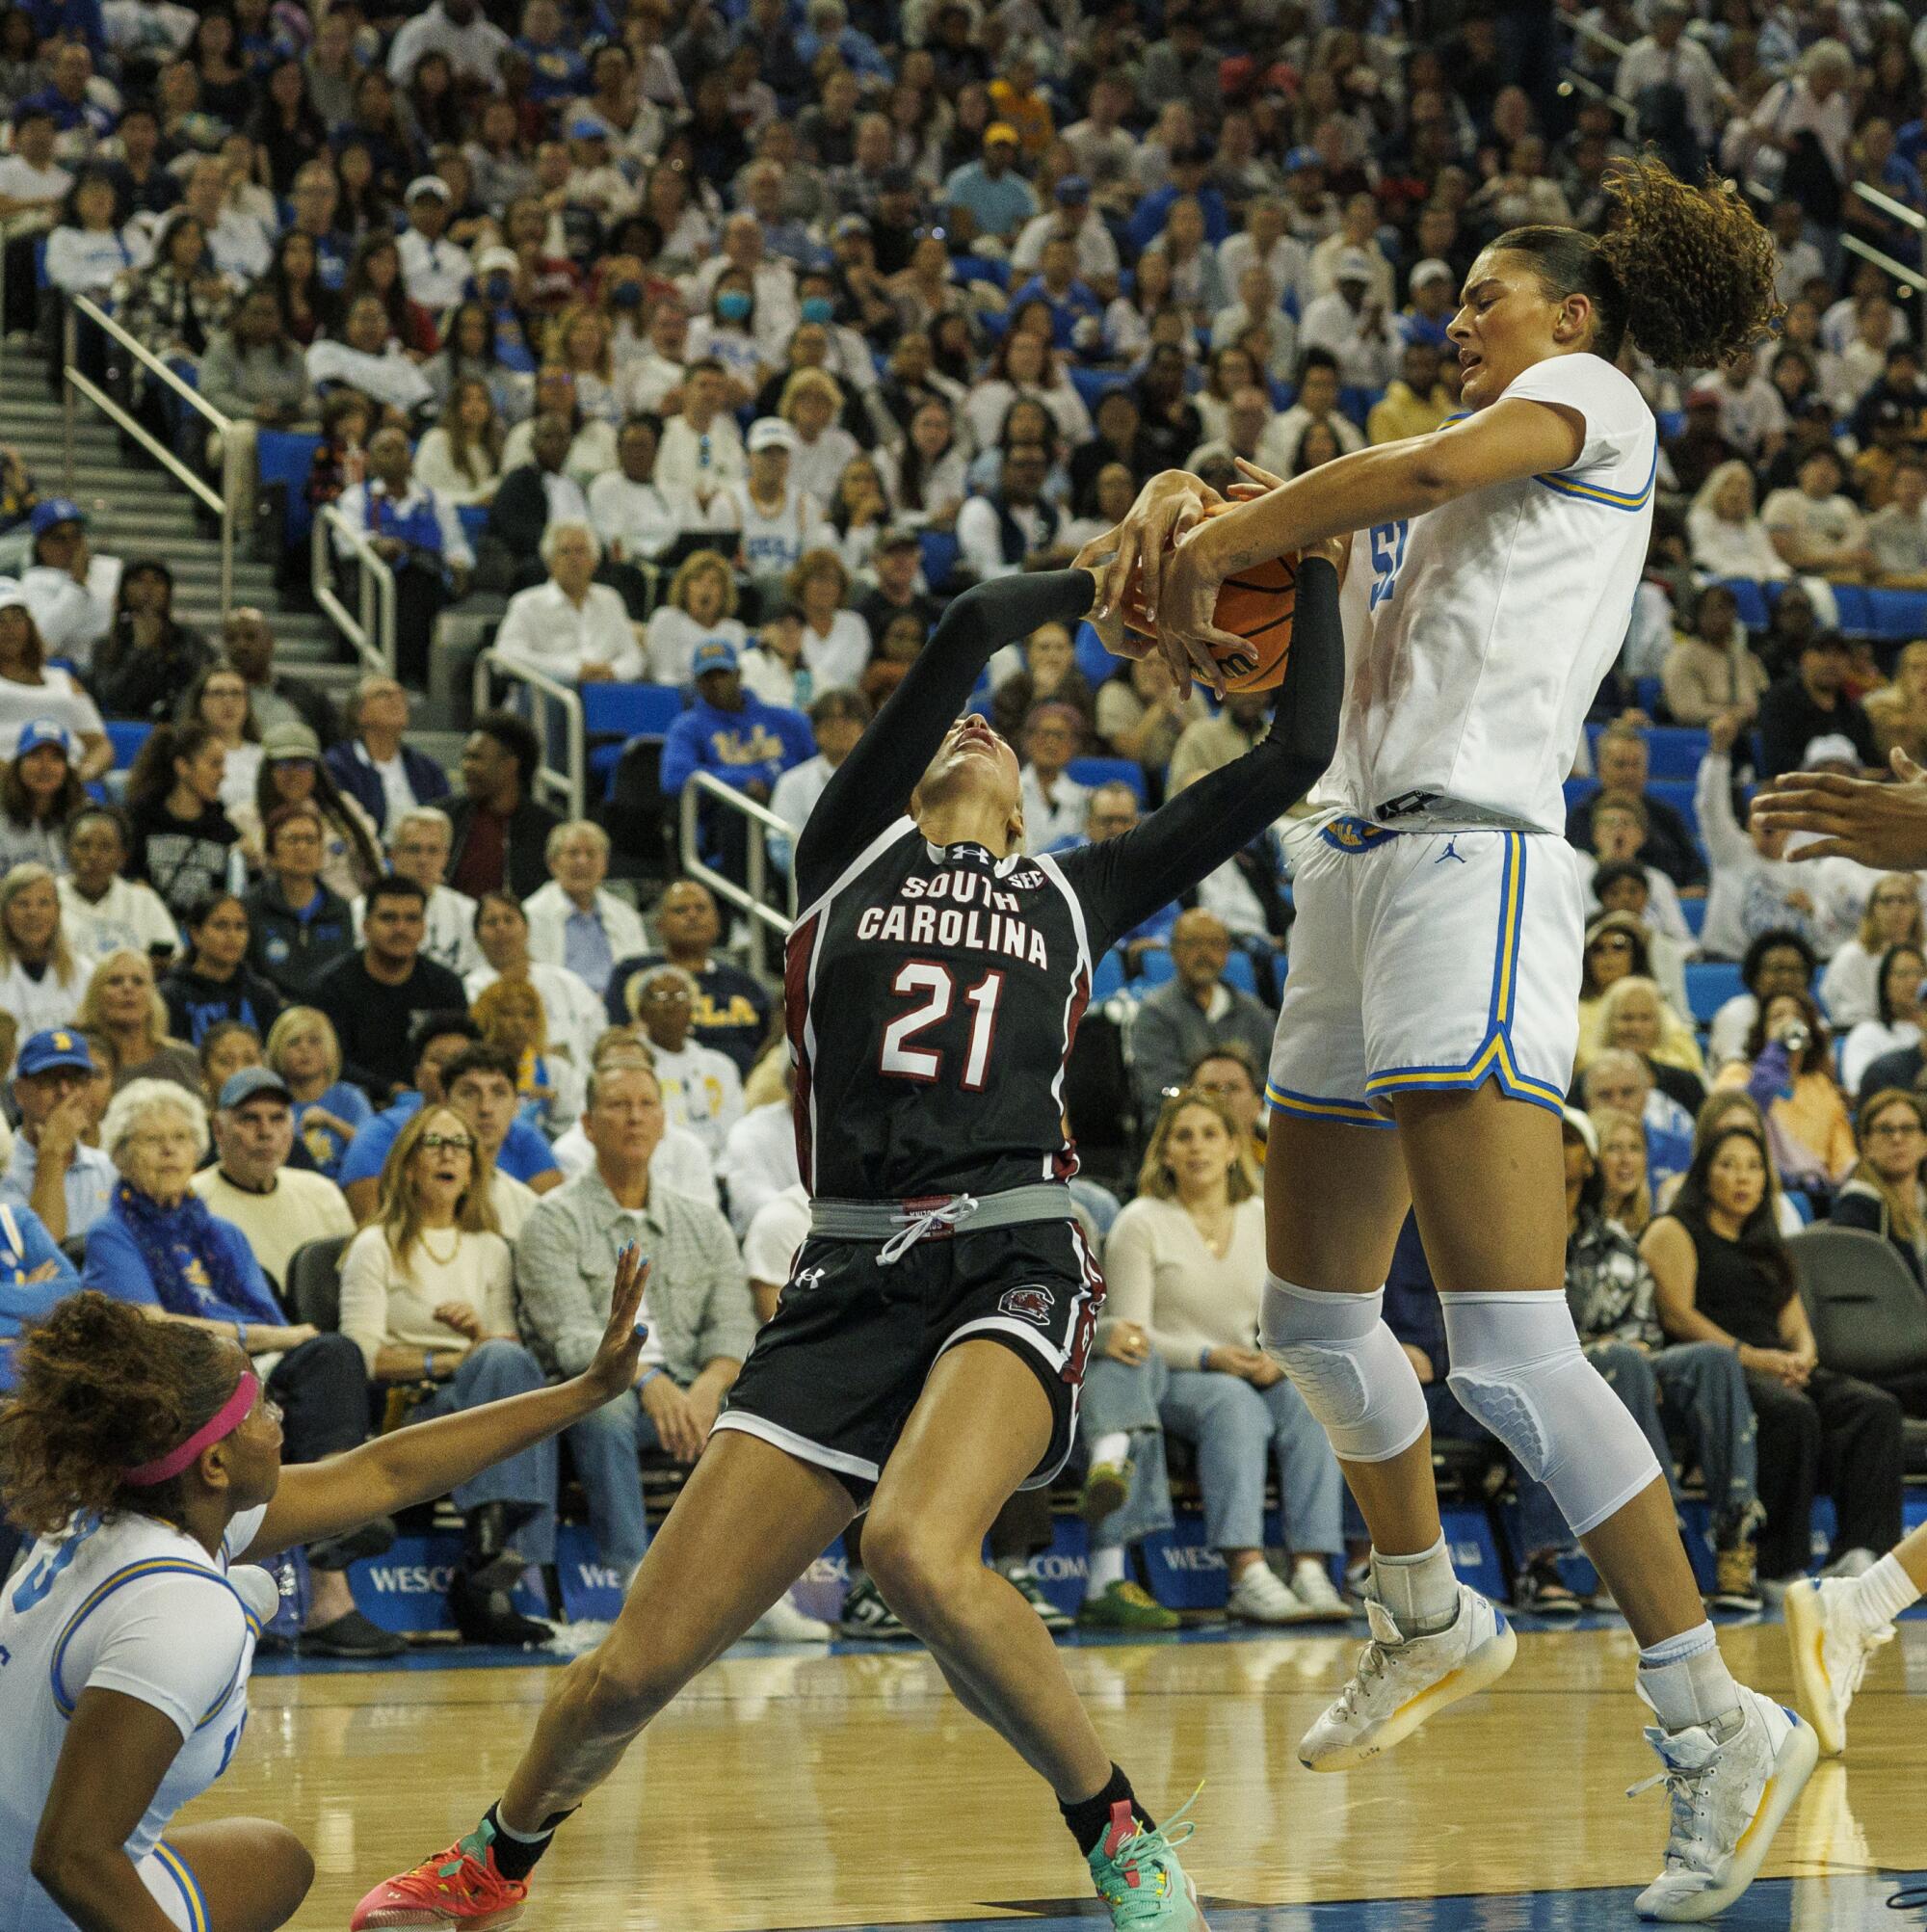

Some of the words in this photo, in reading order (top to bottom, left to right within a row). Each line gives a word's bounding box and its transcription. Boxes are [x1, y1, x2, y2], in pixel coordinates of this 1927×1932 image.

[901, 870, 1020, 913] SOUTH
[1007, 869, 1045, 889] SEC
[857, 904, 1048, 971] CAROLINA
[880, 960, 1005, 1091] 21
